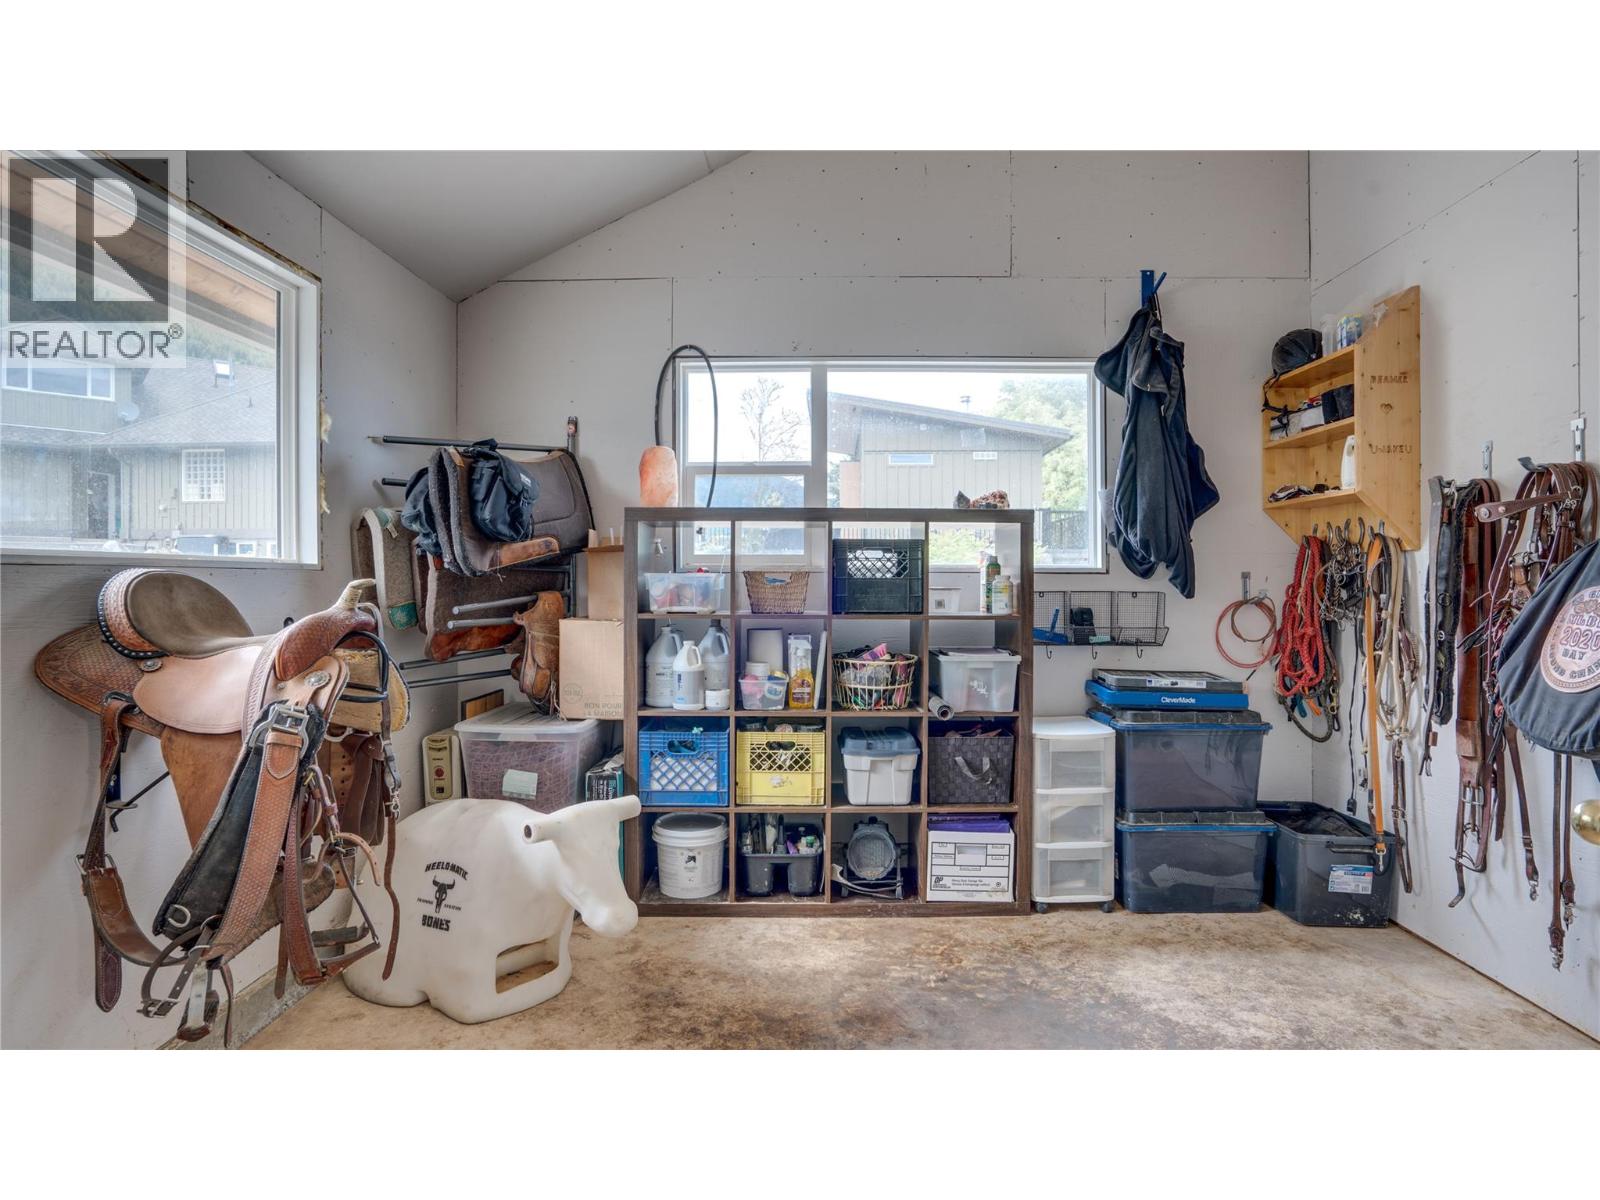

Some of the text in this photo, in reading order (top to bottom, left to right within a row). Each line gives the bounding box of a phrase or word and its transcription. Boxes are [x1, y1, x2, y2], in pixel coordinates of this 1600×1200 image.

[1560, 626, 1600, 651] 2020
[1161, 696, 1196, 704] CleverMade
[421, 914, 451, 932] BONES
